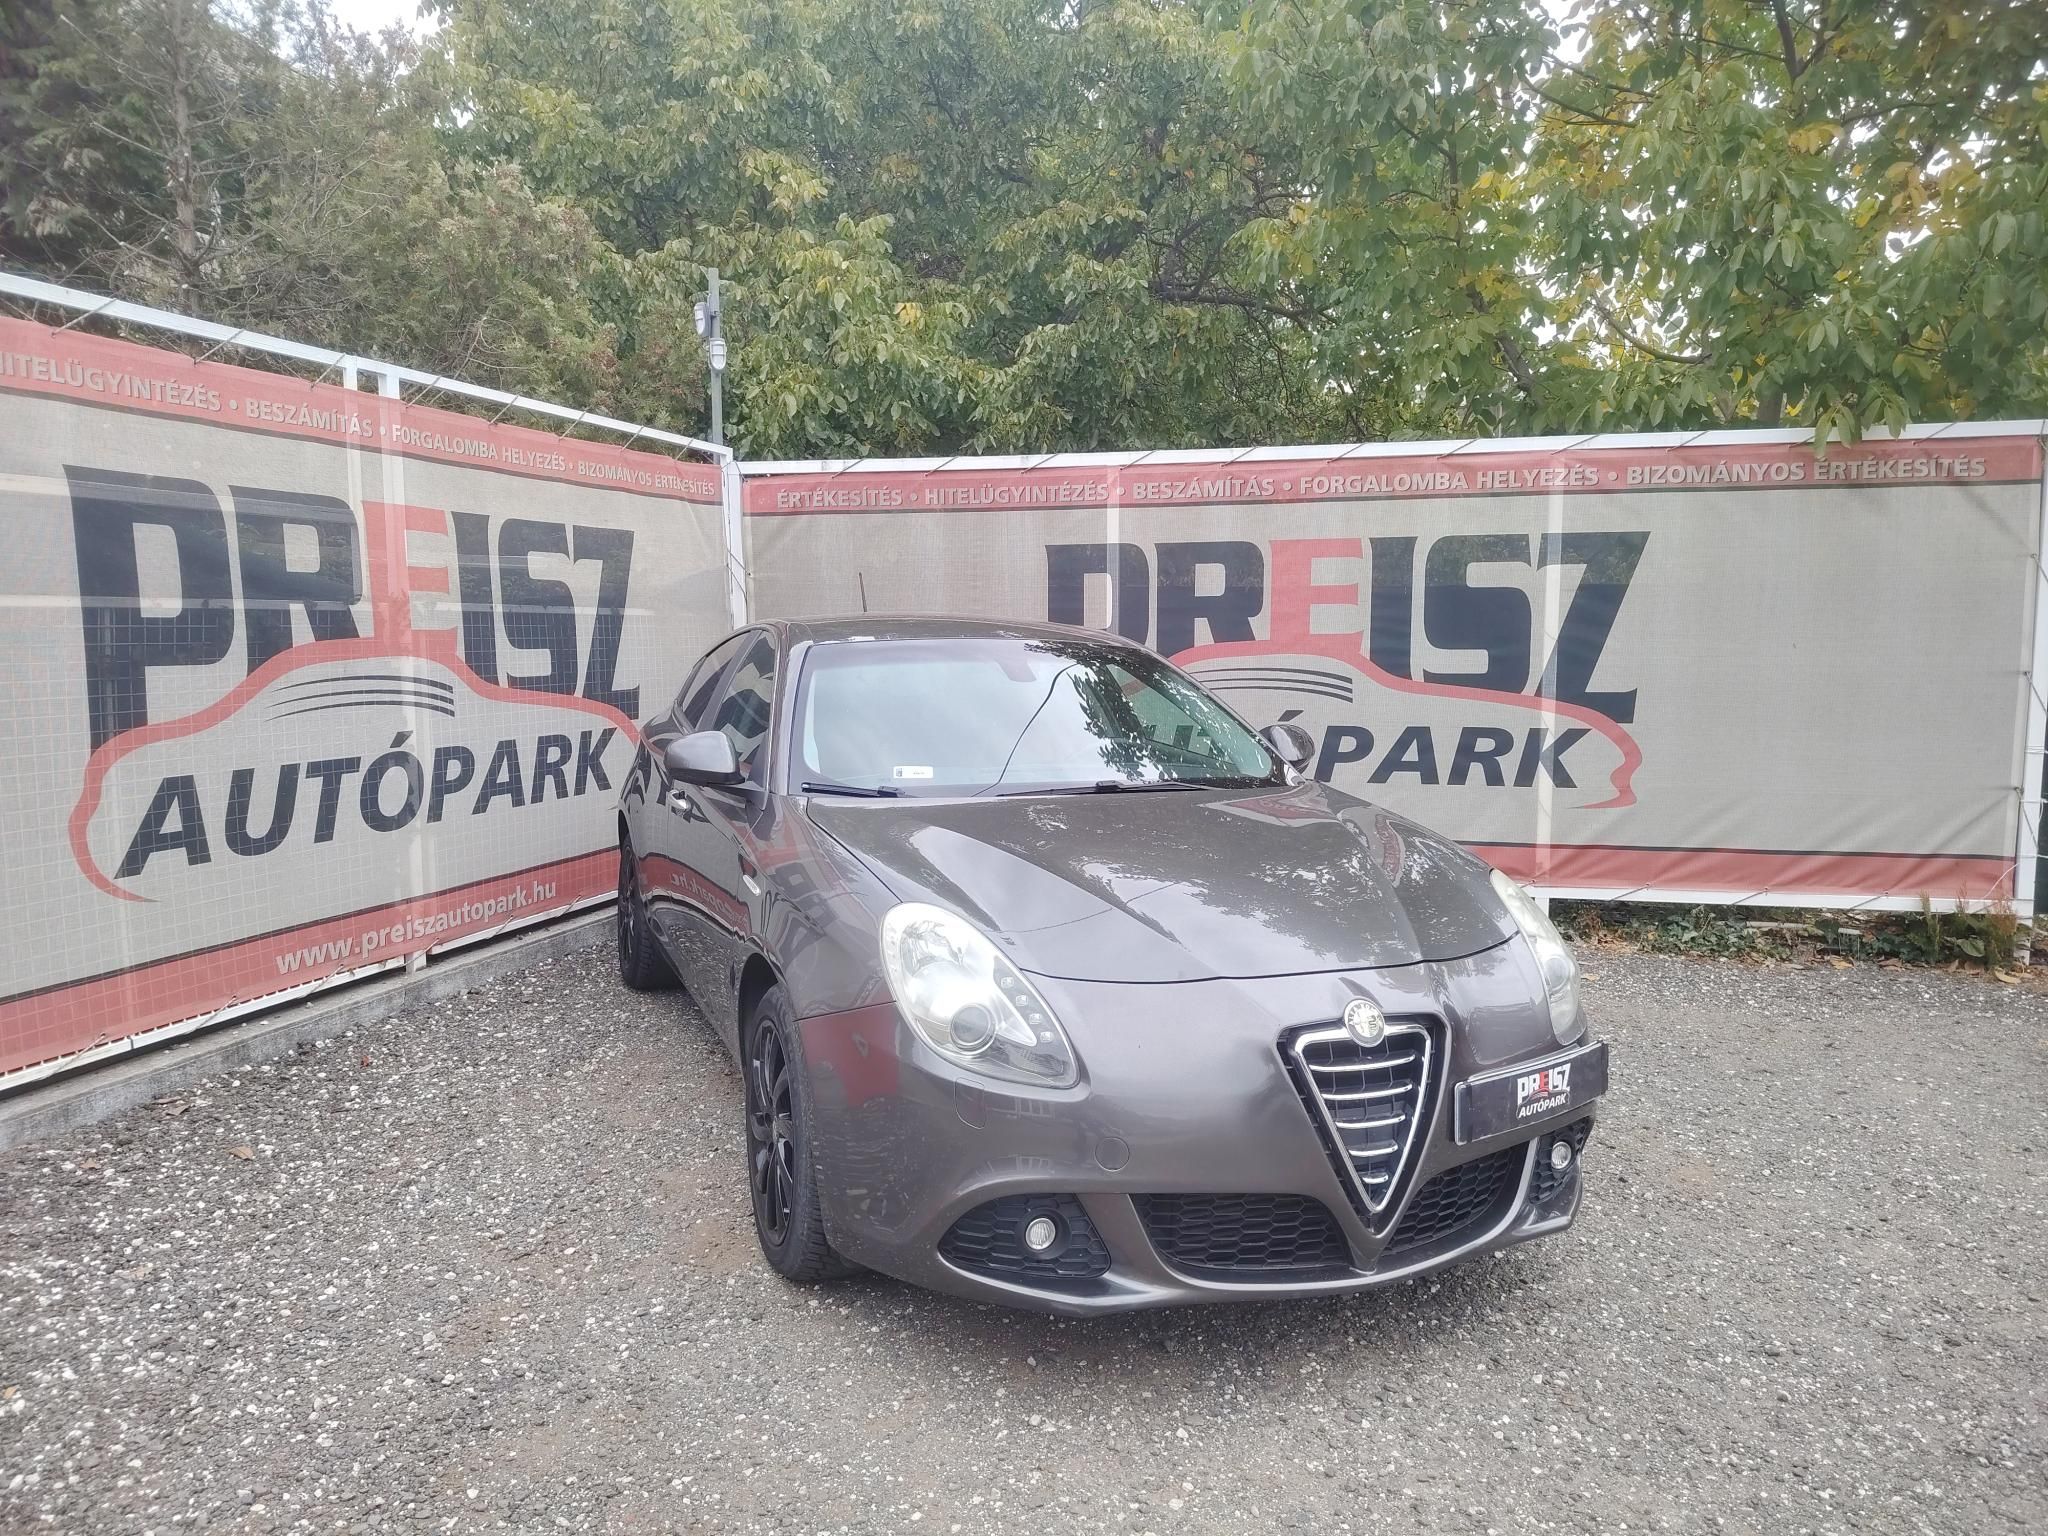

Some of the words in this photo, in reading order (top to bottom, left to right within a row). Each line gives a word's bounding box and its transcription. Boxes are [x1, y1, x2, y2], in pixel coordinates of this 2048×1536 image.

[245, 396, 374, 438] BESZÁMÍTÁS
[391, 423, 499, 462] FORGALOMBA
[502, 448, 566, 473] HELYEZÉS
[577, 460, 652, 487] BIZOMÁNYOS
[655, 469, 715, 496] ÉRTÉKESÍTÉS
[776, 485, 904, 509] ÉRTÉKESÍTÉS
[924, 481, 1109, 506] HITELÜGYINTÉZÉS
[1133, 474, 1276, 500] BESZÁMÍTÁS
[1299, 469, 1470, 496] FORGALOMBA
[1476, 464, 1599, 489] HELYEZÉS
[1626, 460, 1806, 486] BIZOMÁNYOS
[1814, 457, 1987, 483] ÉRTÉKESÍTÉS
[63, 464, 640, 756] PREISZ
[113, 728, 618, 880] AUTÓPARK
[275, 881, 557, 976] www.preiszautopark.hu
[1517, 1063, 1571, 1104] PREISZ
[1518, 1093, 1566, 1118] AUTÓPARK
